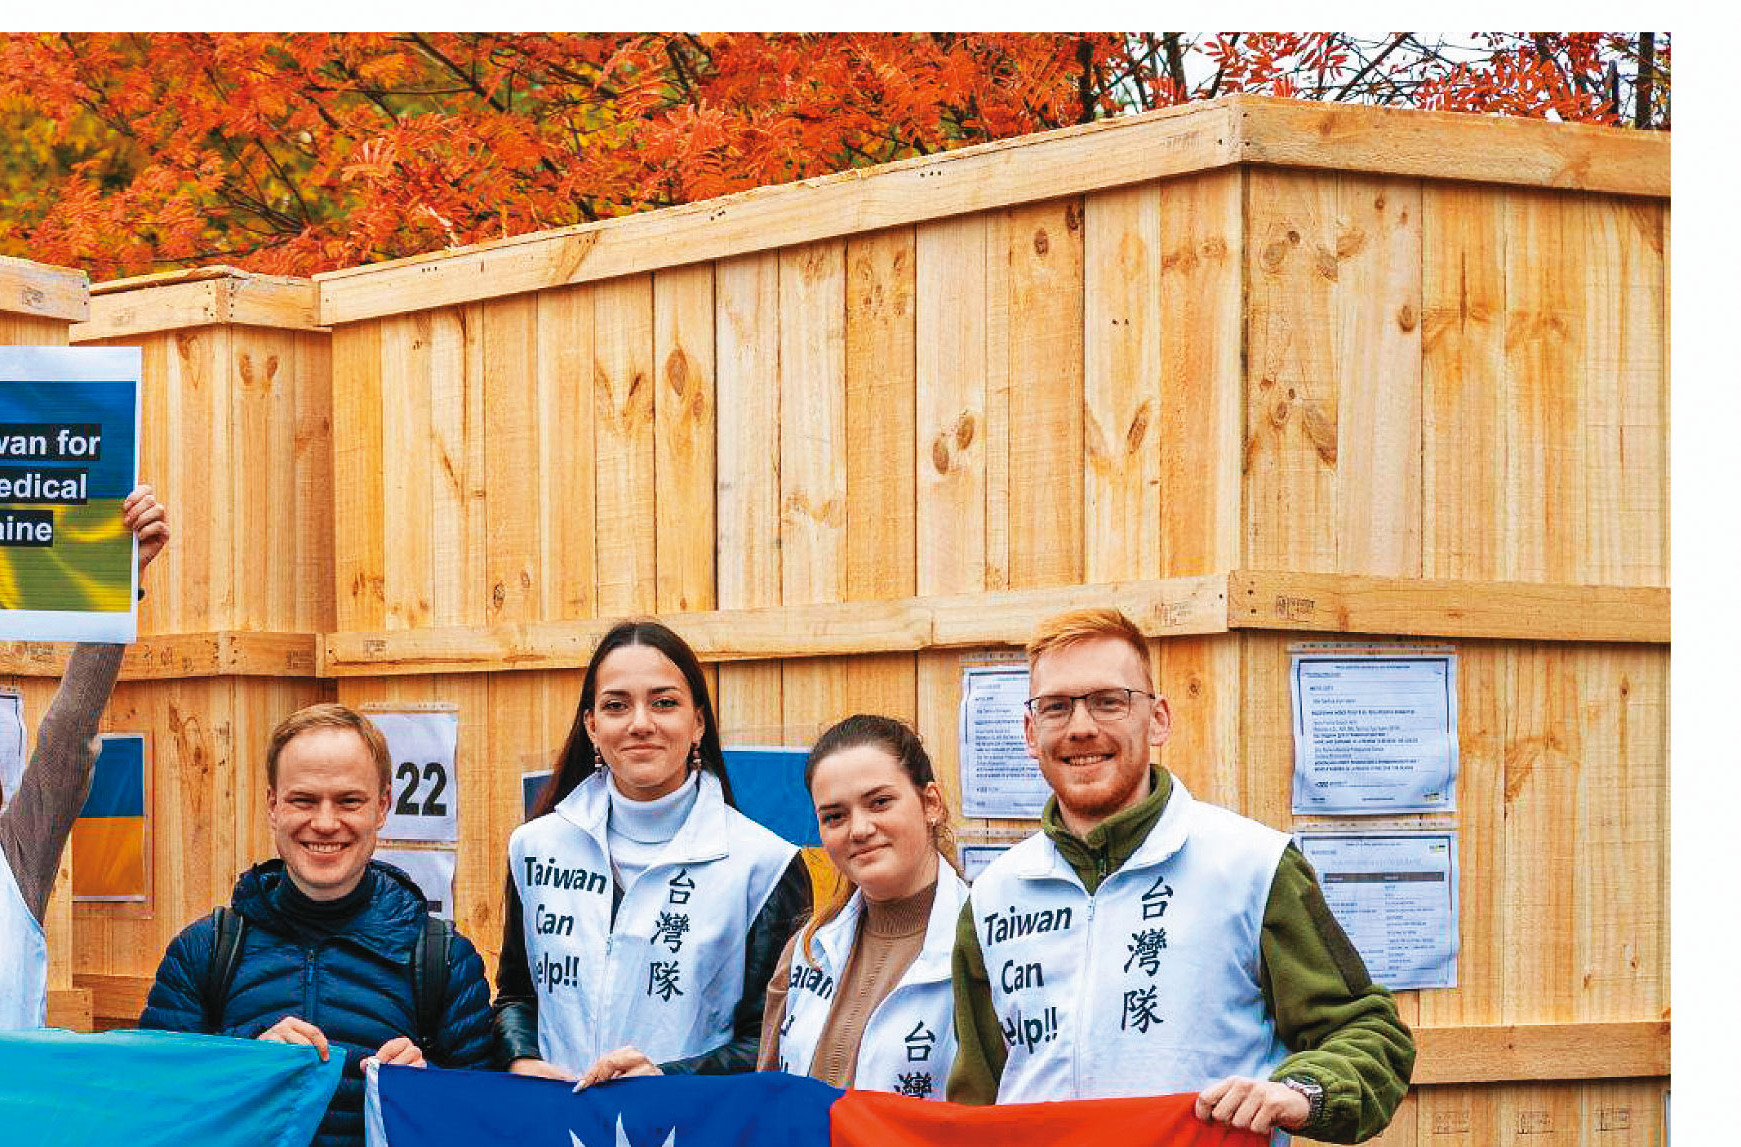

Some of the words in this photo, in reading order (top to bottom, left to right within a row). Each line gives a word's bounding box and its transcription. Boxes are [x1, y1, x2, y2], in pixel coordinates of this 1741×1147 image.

[57, 429, 101, 457] for
[394, 762, 448, 817] 22
[524, 857, 607, 894] Taiwan
[536, 904, 574, 936] Can
[647, 868, 696, 1002] 台灣隊
[984, 905, 1073, 946] Taiwan
[536, 952, 580, 994] elp!!
[1121, 876, 1174, 1034] 台灣隊
[1001, 959, 1044, 995] Can
[1001, 1006, 1058, 1055] elp!!
